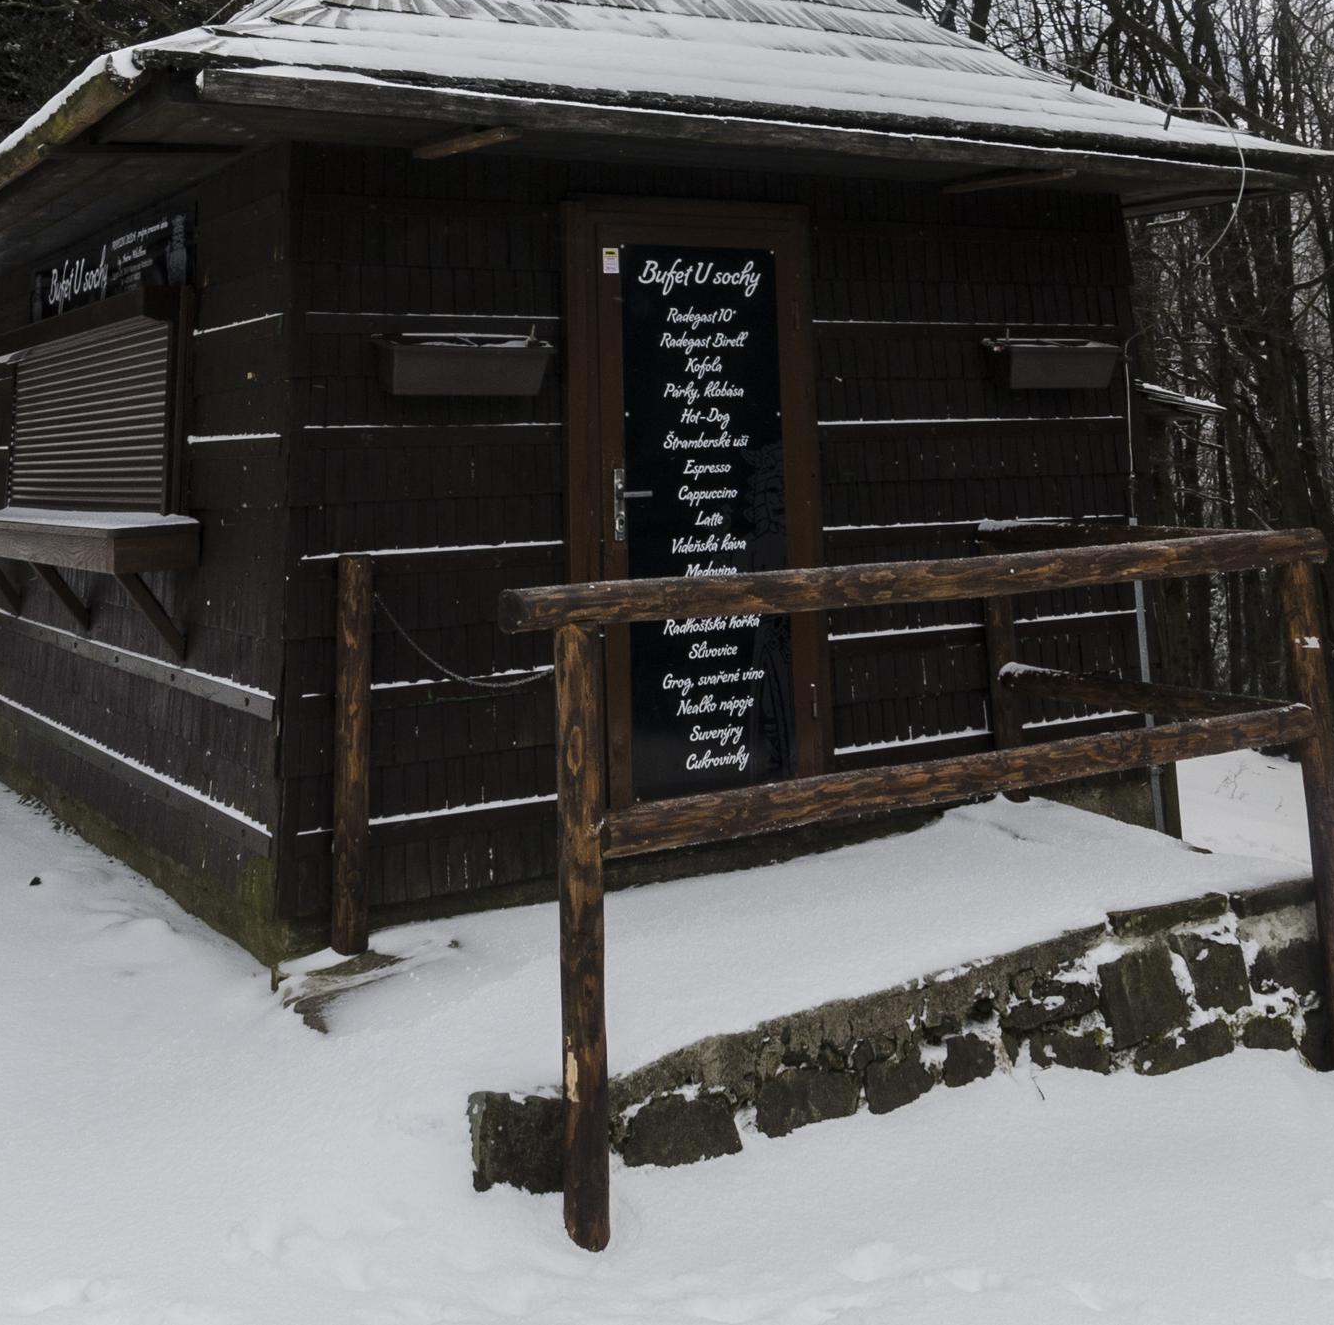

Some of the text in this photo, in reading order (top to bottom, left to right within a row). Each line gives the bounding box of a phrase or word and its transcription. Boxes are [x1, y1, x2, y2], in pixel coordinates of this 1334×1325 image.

[48, 259, 74, 316] Bufet
[74, 258, 85, 295] U
[638, 259, 693, 295] Bufet
[695, 262, 714, 284] U
[713, 261, 761, 297] sochy
[667, 306, 717, 330] Radegast
[660, 331, 748, 355] Radegast Birell
[685, 356, 722, 379] Kofola
[664, 381, 744, 405] Párky, klobása
[680, 408, 730, 430] Hot-Dog
[663, 431, 749, 450] Štramberské uši
[683, 460, 731, 480] Espresso
[678, 485, 738, 506] Cappuccino
[695, 511, 723, 526] Latte
[672, 533, 746, 554] Videňská káva
[689, 641, 738, 659] Slivovice
[663, 667, 765, 696] Grog, svařené víno
[677, 694, 754, 717] Nealko nápoje
[690, 724, 744, 746] Suvenýry
[686, 745, 750, 771] Cukrovinky
